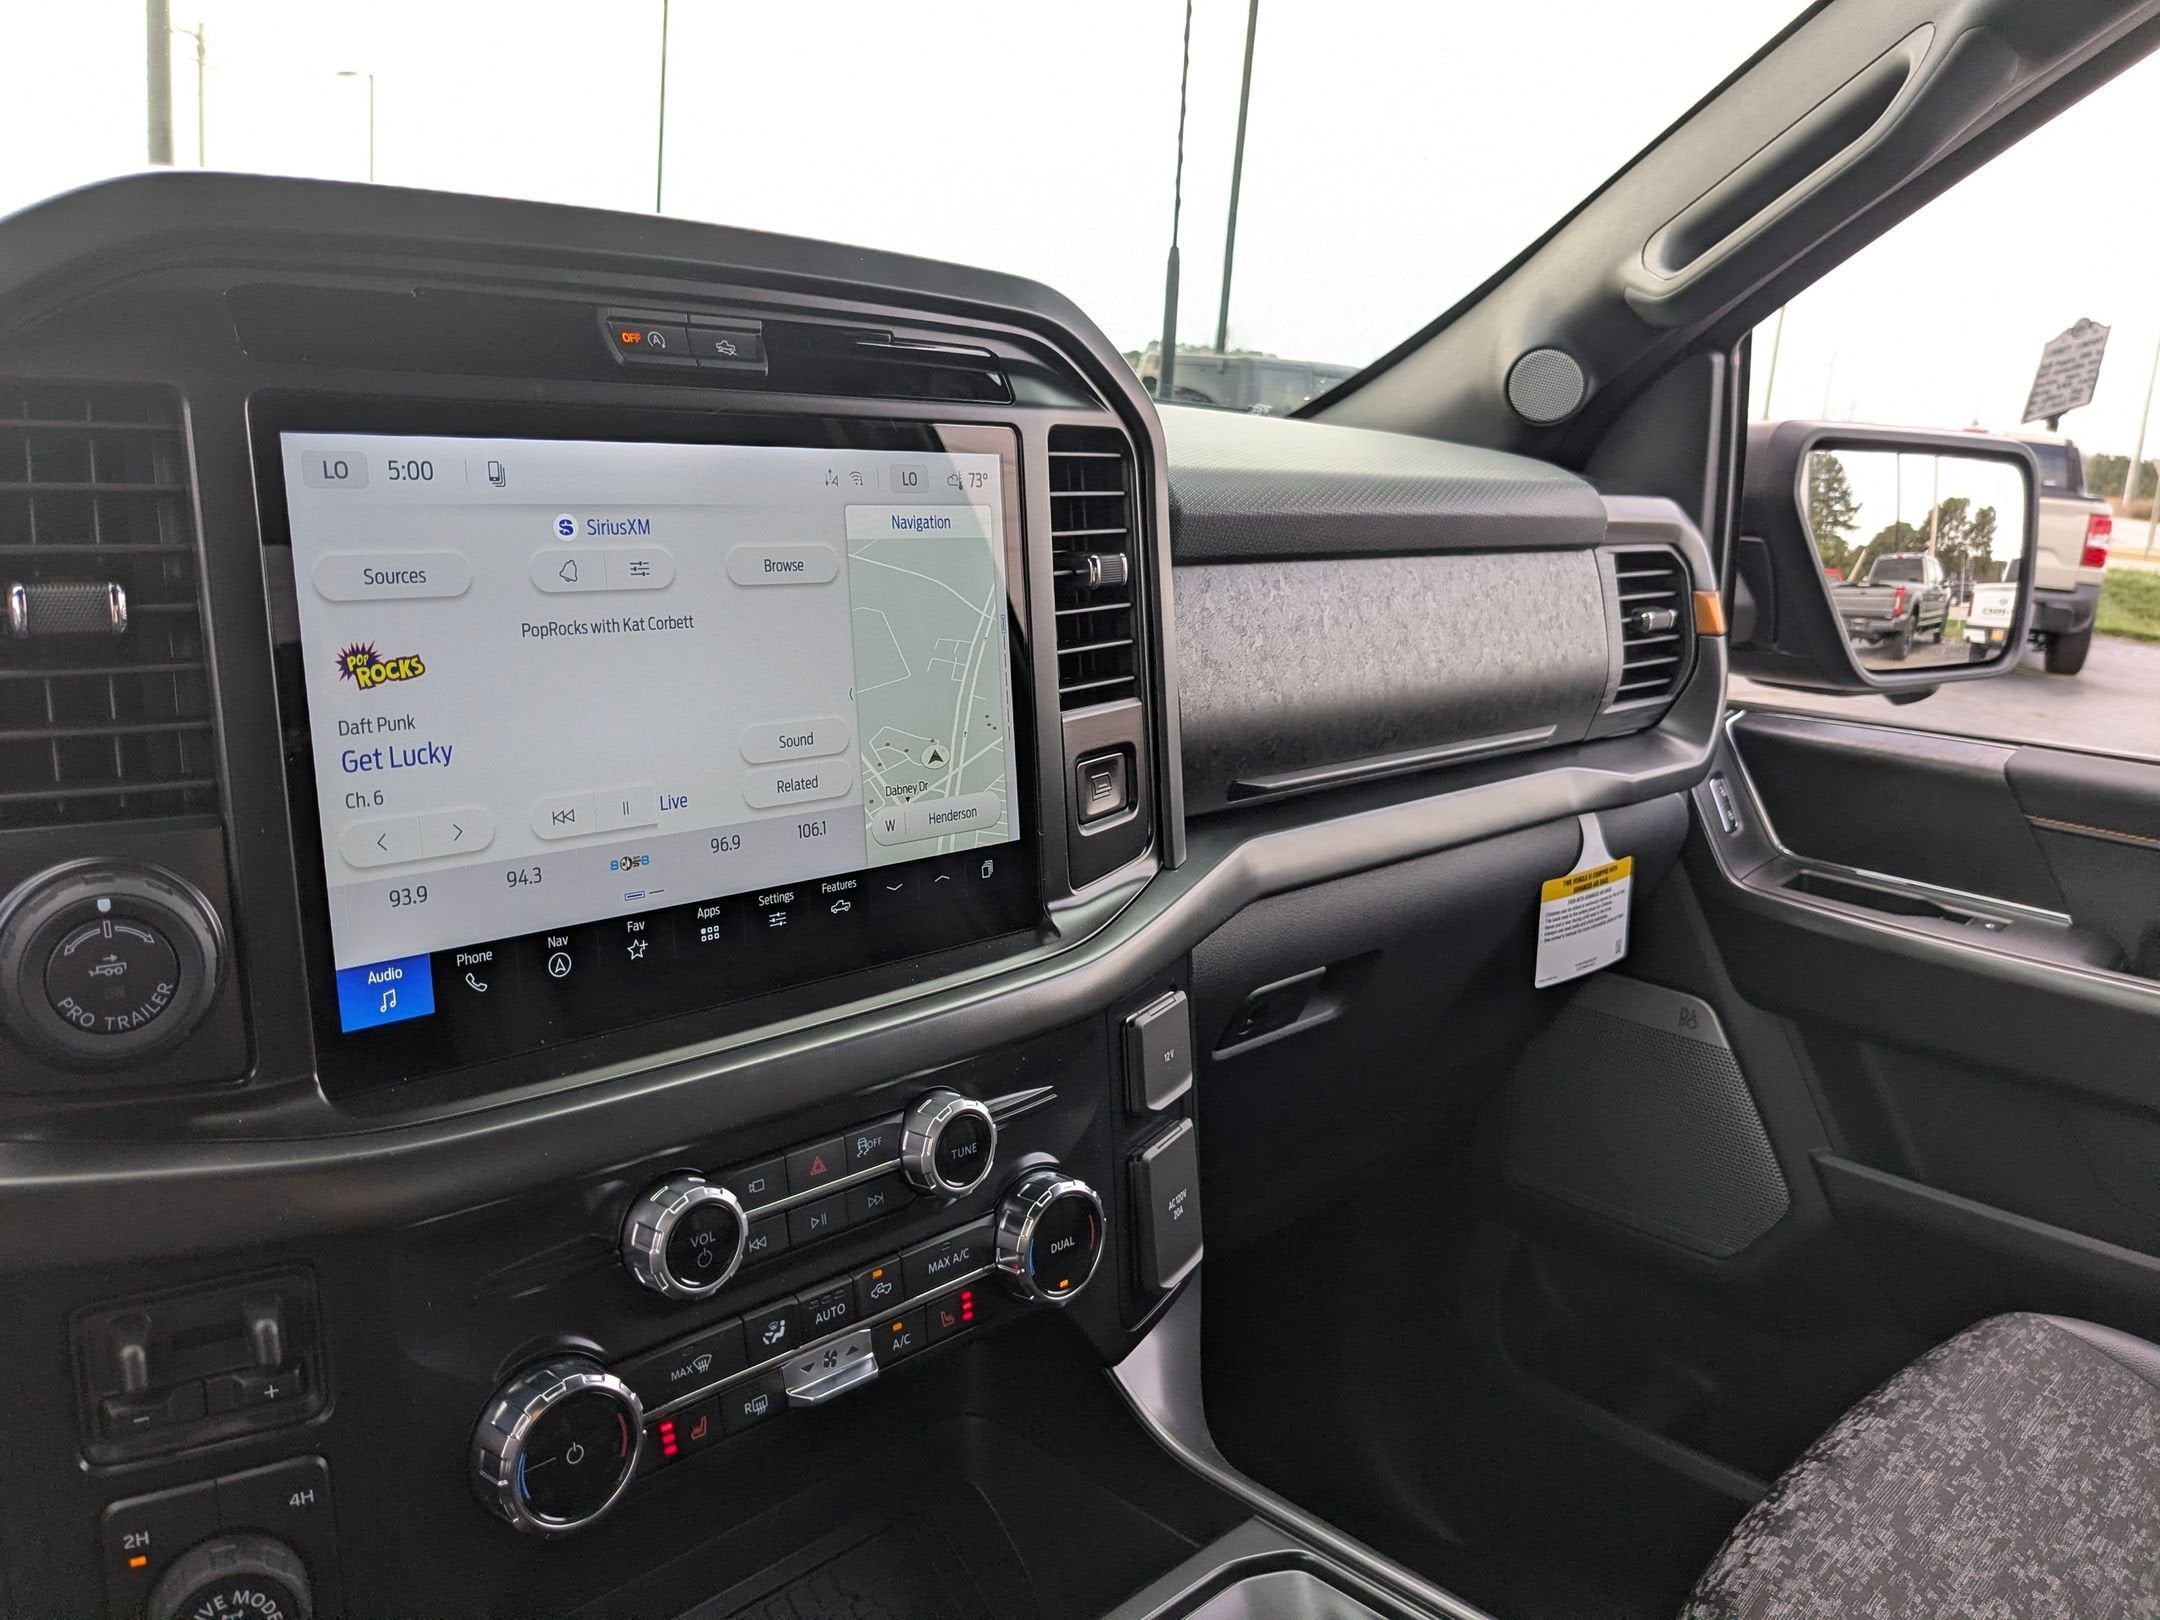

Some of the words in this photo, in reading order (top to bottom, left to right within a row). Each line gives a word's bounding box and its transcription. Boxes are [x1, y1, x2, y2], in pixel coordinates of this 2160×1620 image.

[622, 332, 641, 344] OFF
[323, 460, 349, 480] LO
[387, 460, 434, 482] 5:00
[902, 471, 918, 487] LO
[968, 472, 989, 489] 73°
[586, 518, 651, 537] SiriusXM
[891, 515, 951, 533] Navigation
[764, 559, 804, 573] Browse
[363, 567, 427, 586] Sources
[521, 620, 589, 639] PopRocks
[590, 617, 620, 635] with
[623, 616, 645, 632] Kat
[647, 614, 694, 632] Corbett
[346, 652, 370, 672] POP
[356, 654, 425, 690] ROCKS
[338, 718, 373, 737] Daft
[376, 714, 416, 733] Punk
[778, 732, 814, 749] Sound
[341, 748, 383, 774] Get
[389, 741, 453, 769] Lucky
[776, 775, 819, 793] Related
[885, 783, 917, 798] Dabney
[918, 781, 928, 793] Dr
[345, 792, 371, 810] Ch.
[372, 790, 385, 806] 6
[659, 795, 688, 811] Live
[928, 806, 977, 825] Henderson
[797, 821, 827, 839] 106.1
[884, 819, 896, 832] W
[710, 834, 741, 854] 96.9
[506, 866, 543, 888] 94.3
[821, 878, 857, 893] Features
[389, 885, 428, 907] 93.9
[758, 890, 795, 907] Settings
[697, 905, 721, 921] Apps
[626, 920, 645, 932] Fav
[547, 935, 569, 948] Nav
[456, 950, 493, 966] Phone
[367, 967, 403, 985] Audio
[58, 997, 95, 1027] PRO
[104, 983, 173, 1031] TRAILER
[868, 1135, 882, 1149] OFF
[951, 1142, 978, 1160] TUNE
[690, 1231, 716, 1248] VOL
[1050, 1236, 1075, 1254] DUAL
[928, 1255, 950, 1274] MAX
[952, 1248, 970, 1265] A/C
[815, 1303, 846, 1325] AUTO
[892, 1334, 911, 1351] A/C
[671, 1364, 694, 1381] MAX
[289, 1490, 314, 1506] 4H
[123, 1531, 149, 1550] 2H
